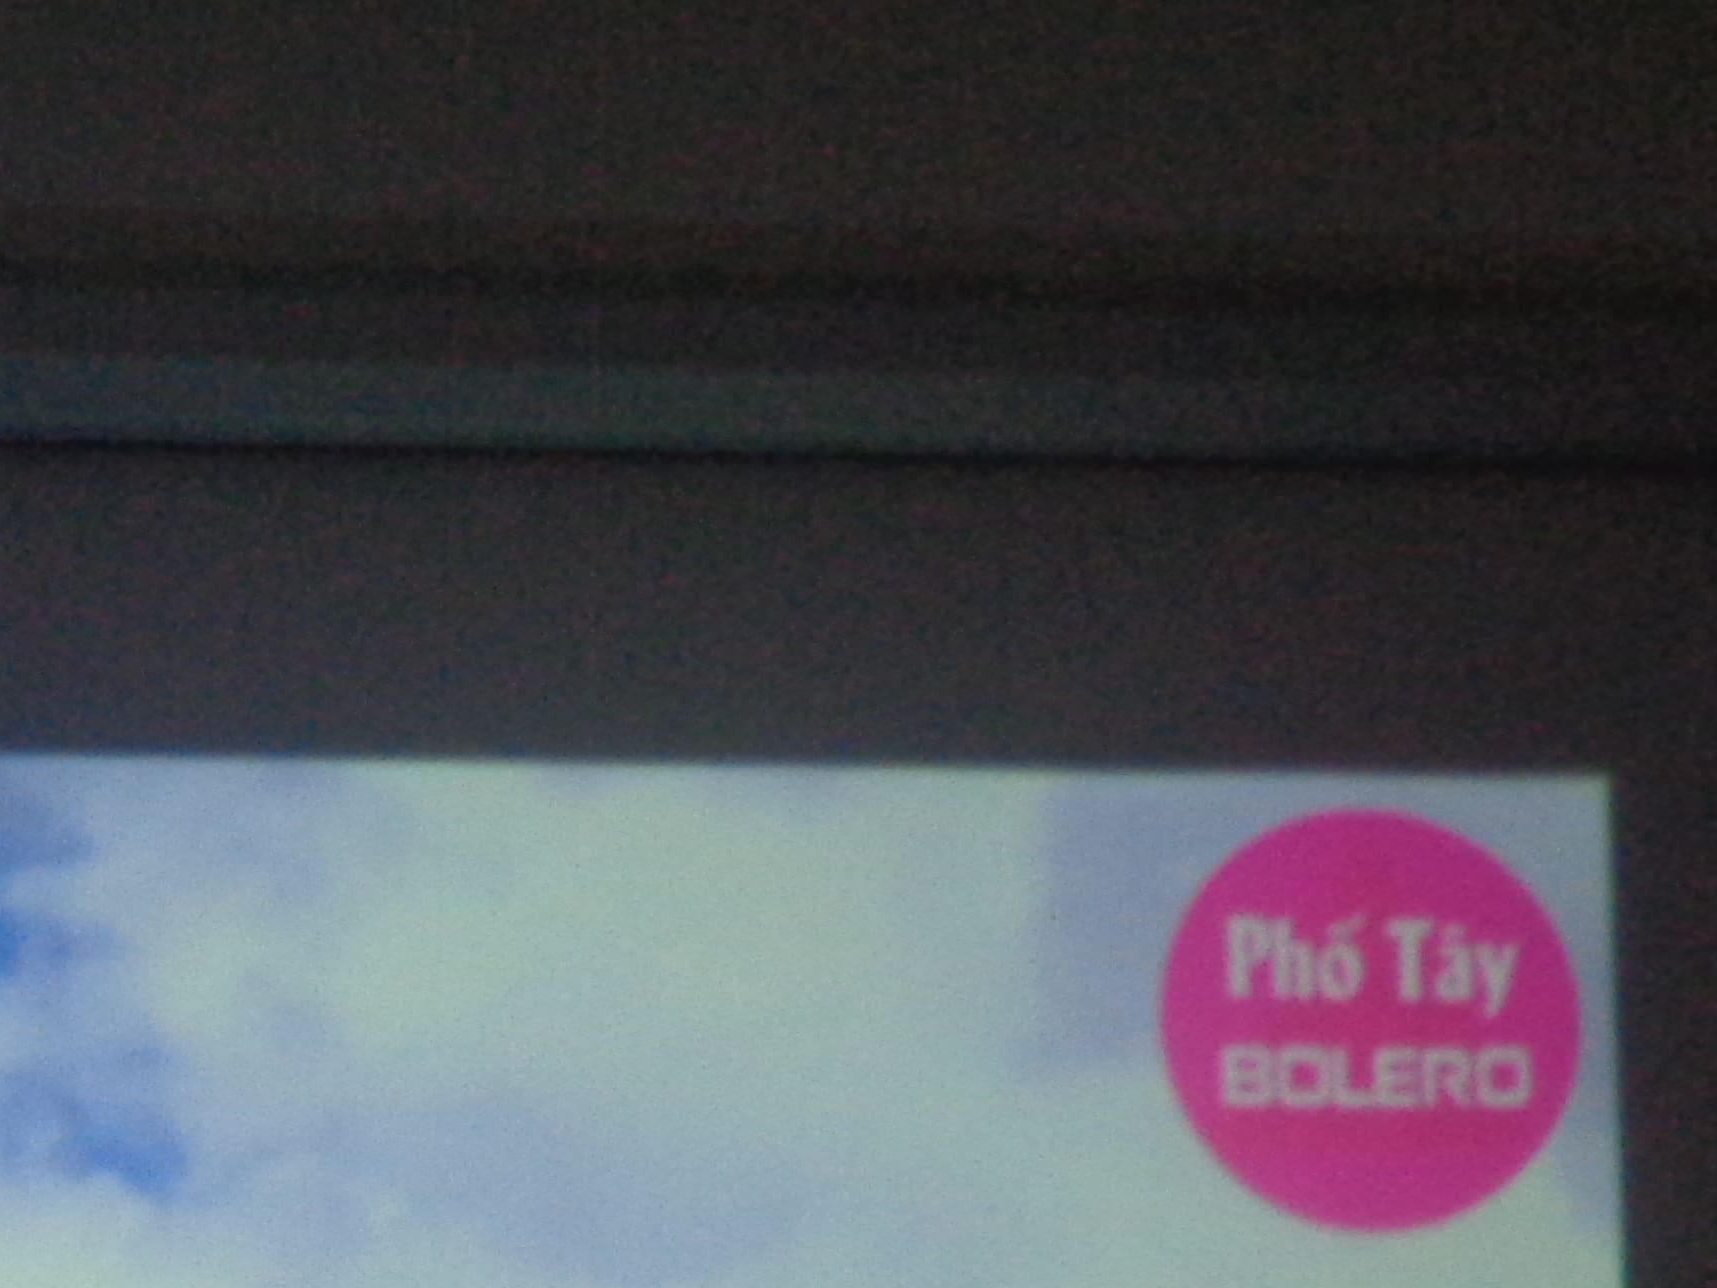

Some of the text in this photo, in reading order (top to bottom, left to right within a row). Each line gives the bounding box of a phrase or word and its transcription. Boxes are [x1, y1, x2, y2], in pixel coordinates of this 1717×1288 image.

[1224, 911, 1521, 1017] Phố Tây
[1219, 1043, 1532, 1109] BOLERO
